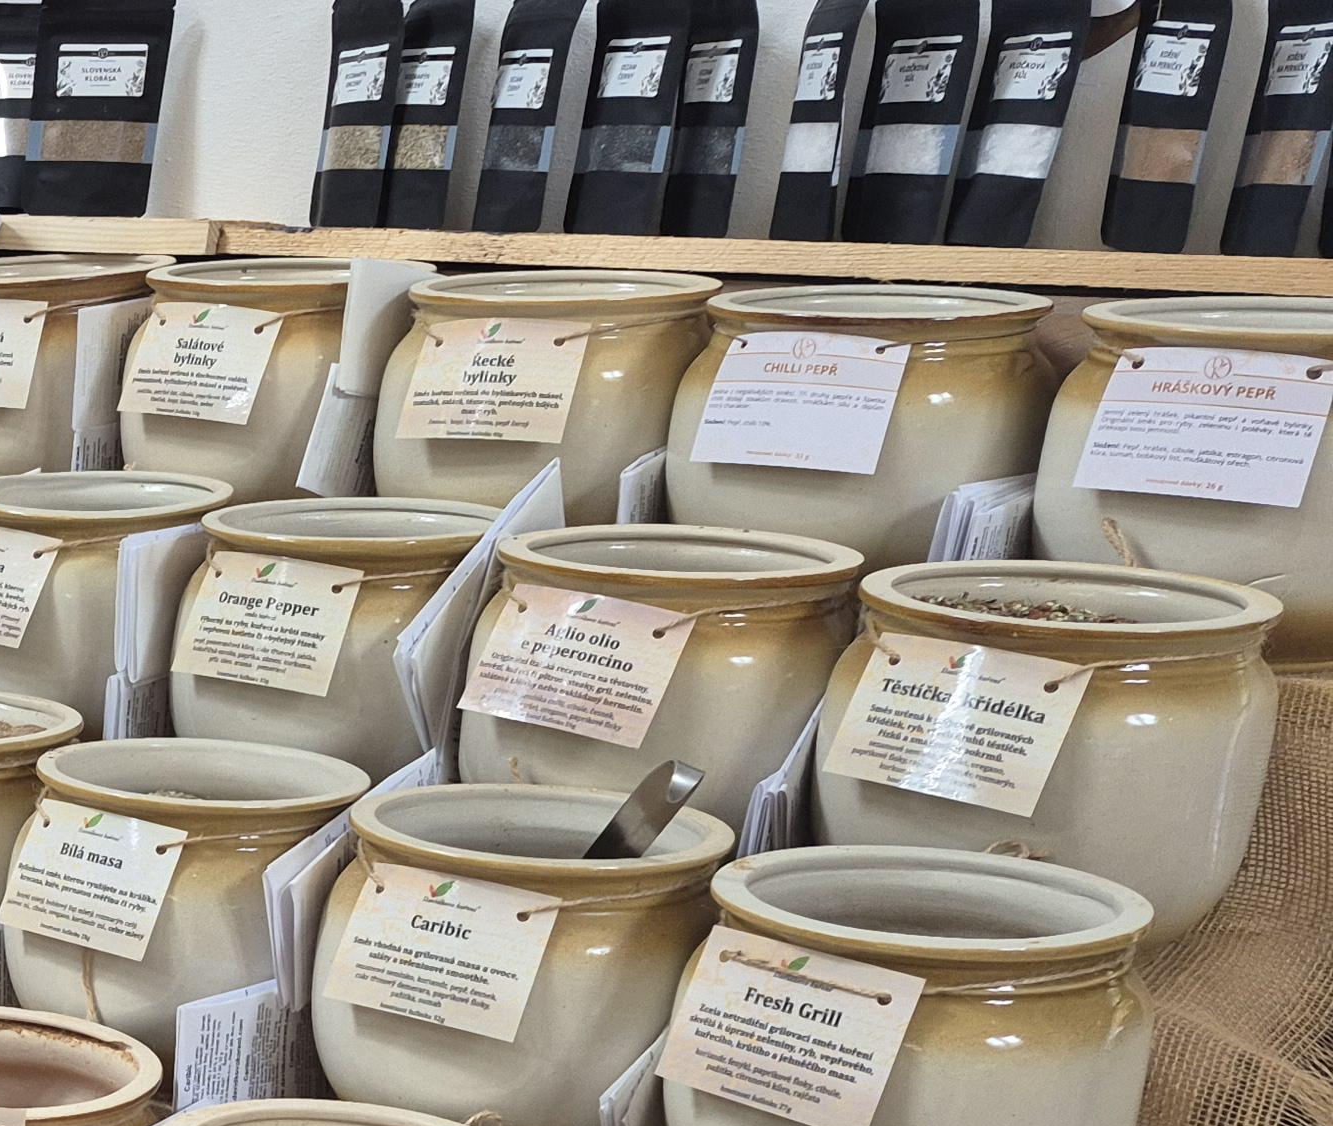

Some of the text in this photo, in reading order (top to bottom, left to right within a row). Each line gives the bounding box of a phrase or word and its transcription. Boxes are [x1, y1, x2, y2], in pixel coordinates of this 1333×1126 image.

[174, 336, 226, 354] Salátové
[172, 353, 219, 370] bylinky
[471, 352, 516, 368] Řecké
[763, 361, 839, 376] CHILLI PEPŘ
[463, 370, 518, 387] bylinky
[1151, 380, 1277, 401] HRÁŠKOVÝ PEPŘ
[218, 591, 320, 618] Orange Pepper
[544, 622, 622, 651] Aglio olio
[520, 639, 634, 674] e peperoncino
[963, 692, 1047, 725] křidélka
[59, 841, 124, 870] Bílá masa
[410, 913, 473, 941] Caribic
[742, 985, 844, 1029] Fresh Grill
[699, 1003, 875, 1061] Zcela netradiční grilovací směs koření
